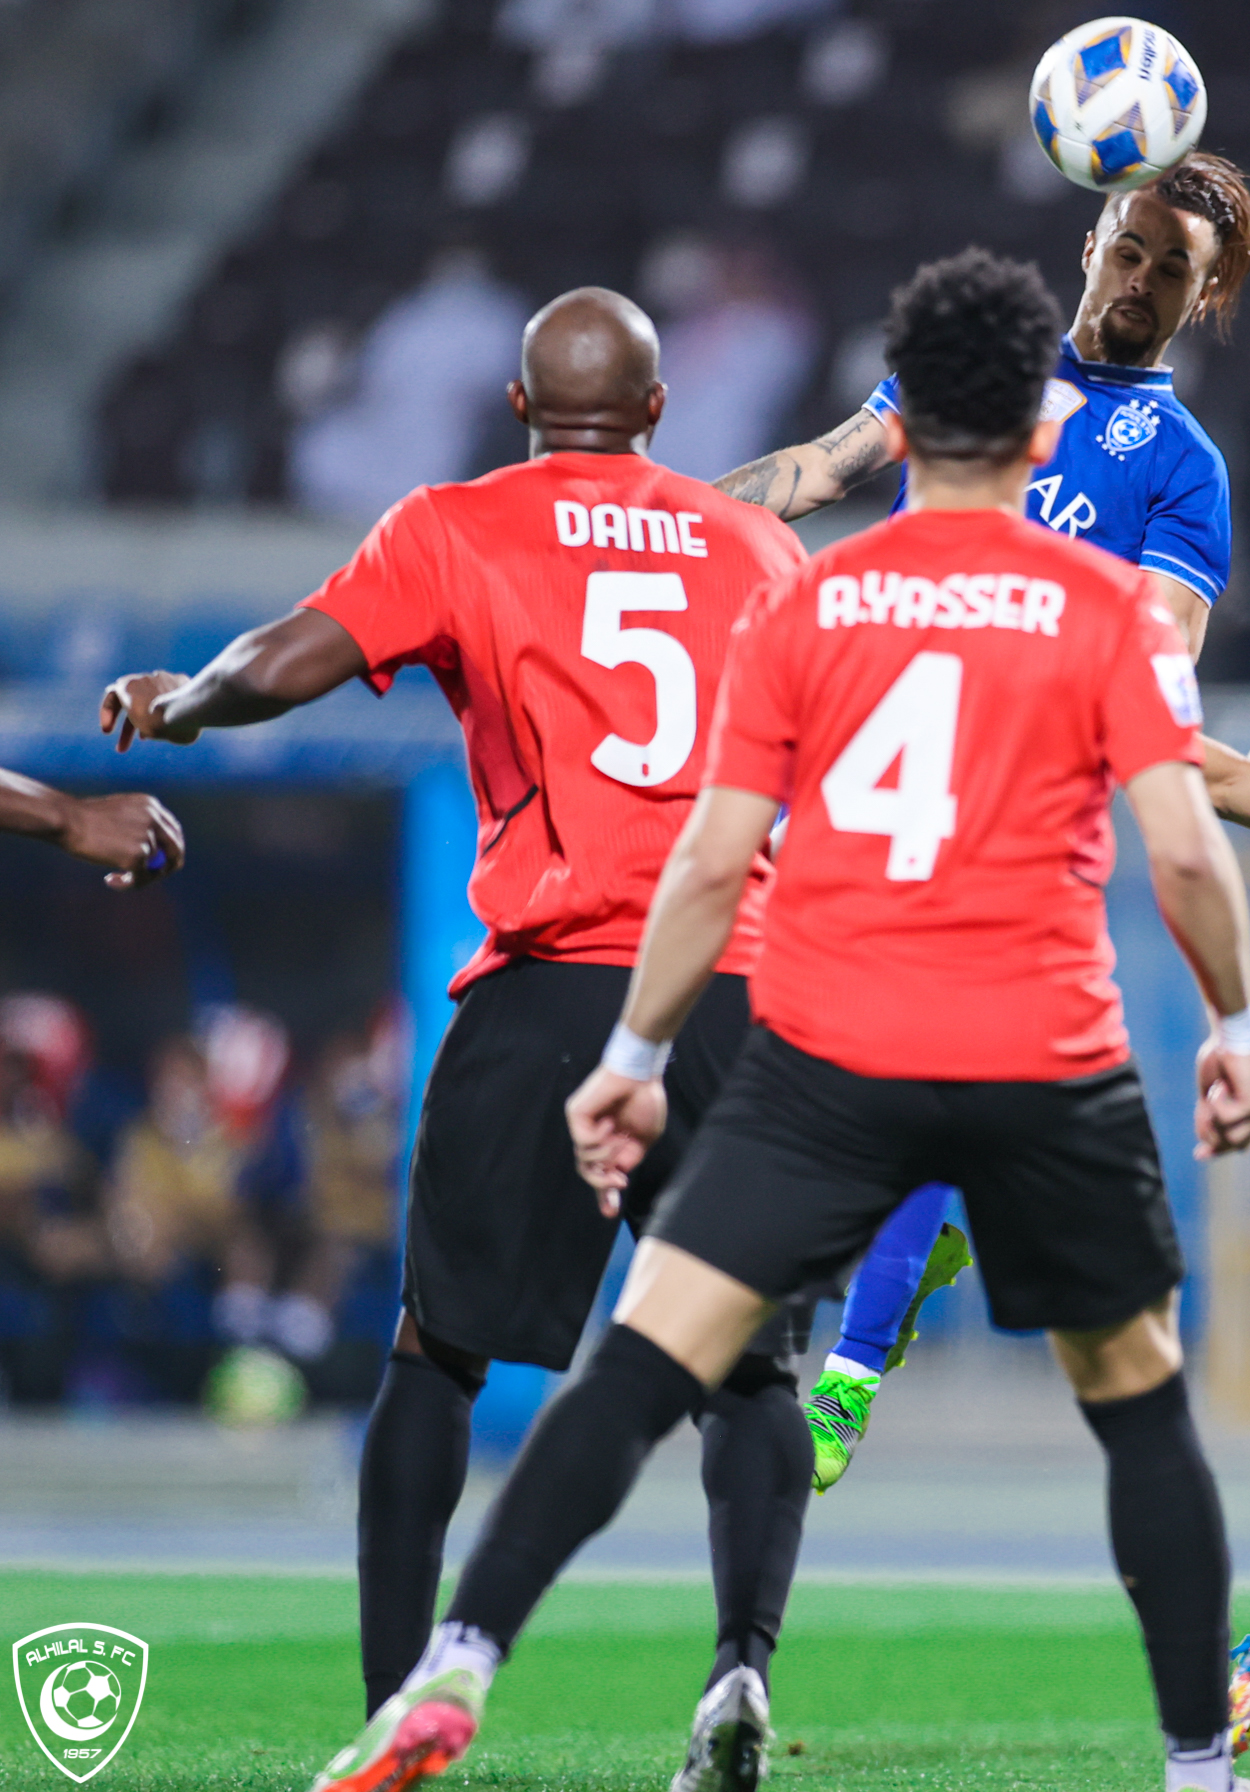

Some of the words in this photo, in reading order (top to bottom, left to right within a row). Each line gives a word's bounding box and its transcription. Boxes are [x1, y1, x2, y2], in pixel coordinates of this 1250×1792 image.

[555, 501, 707, 557] DAME
[818, 571, 1066, 636] A.YASSER
[581, 571, 697, 787] 5
[821, 651, 963, 881] 4
